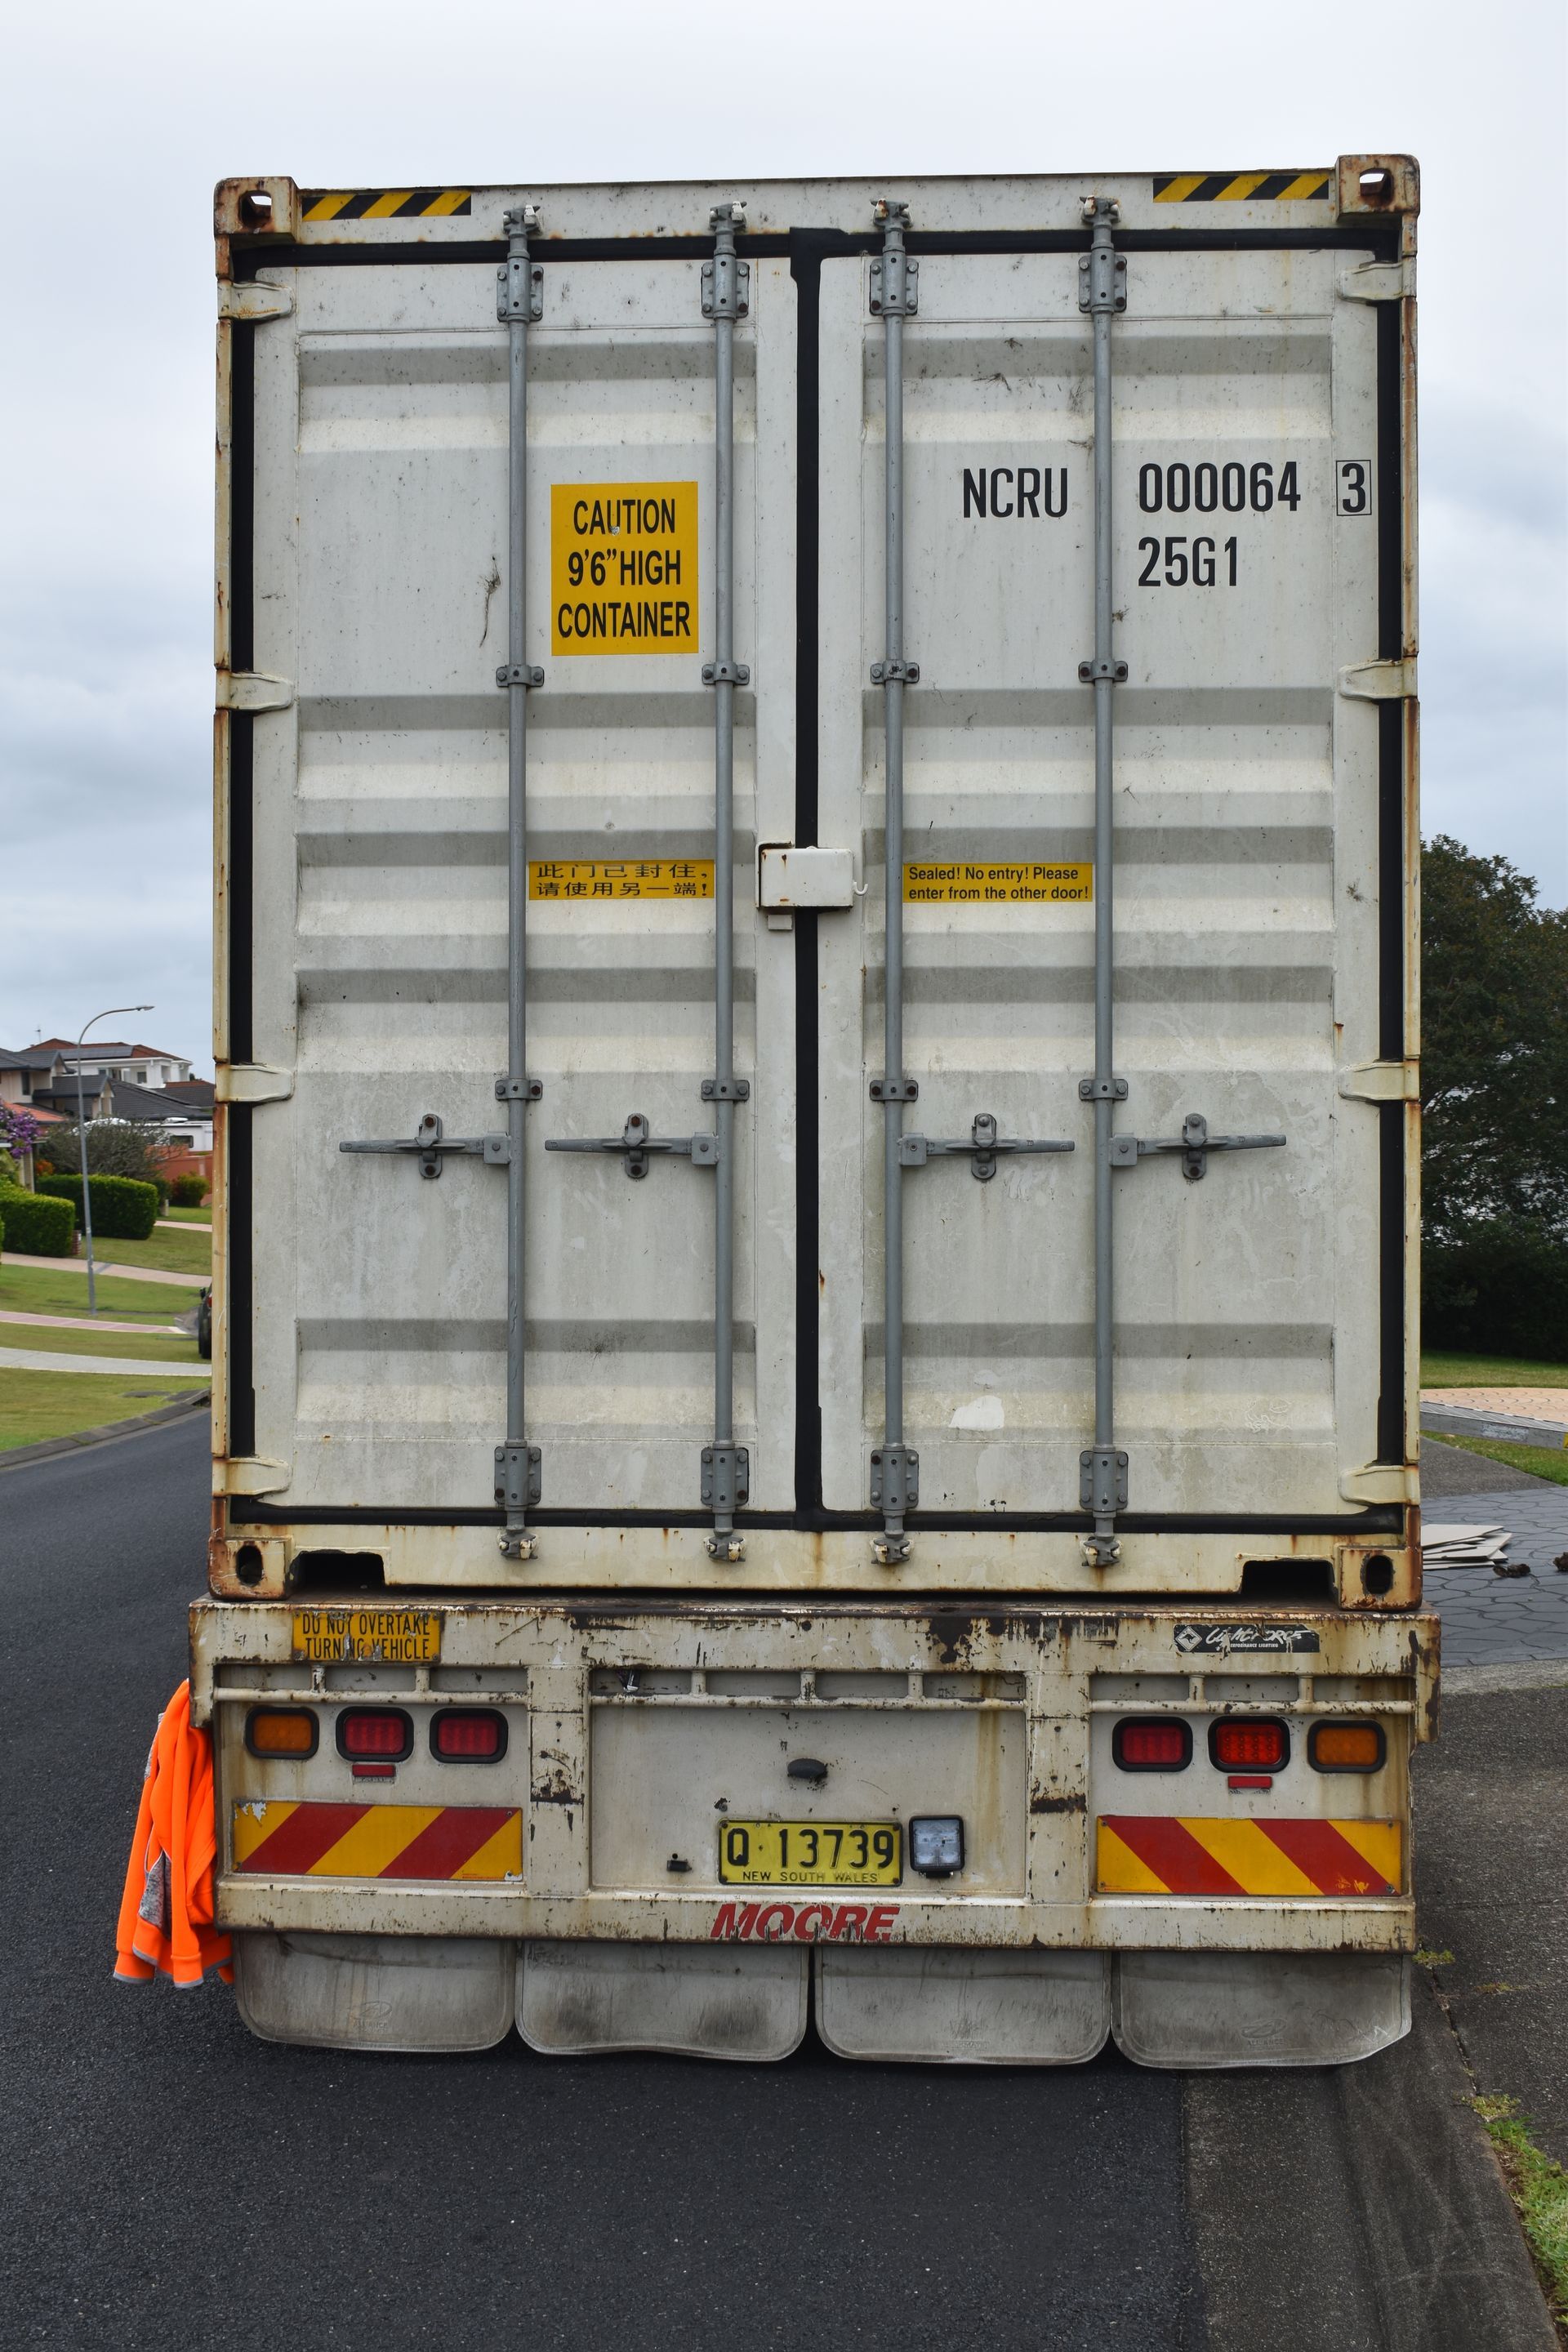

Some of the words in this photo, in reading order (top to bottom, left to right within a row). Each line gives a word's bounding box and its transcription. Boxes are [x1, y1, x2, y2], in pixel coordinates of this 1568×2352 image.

[962, 467, 1068, 518] NCRU
[1138, 461, 1301, 513] 000064
[1341, 462, 1366, 513] 3
[573, 498, 675, 535] CAUTION
[1138, 536, 1238, 587] 25G1
[558, 601, 691, 638] CONTAINER
[908, 866, 960, 880] Sealed!
[965, 866, 984, 880] No
[987, 866, 1029, 883] entry!
[1033, 866, 1079, 880] Please
[908, 887, 944, 899] enter
[948, 886, 980, 899] from
[984, 886, 1006, 899] the
[1010, 886, 1047, 899] other
[1050, 885, 1089, 899] door!
[302, 1613, 320, 1635] DO
[327, 1613, 354, 1635] NOT
[359, 1614, 430, 1636] OVERTAKE
[372, 1637, 430, 1659] VEHICLE
[778, 1829, 894, 1869] 13739
[742, 1871, 772, 1881] NEW
[780, 1872, 825, 1882] SOUTH
[835, 1873, 878, 1882] WALES
[710, 1903, 901, 1941] MOORE
